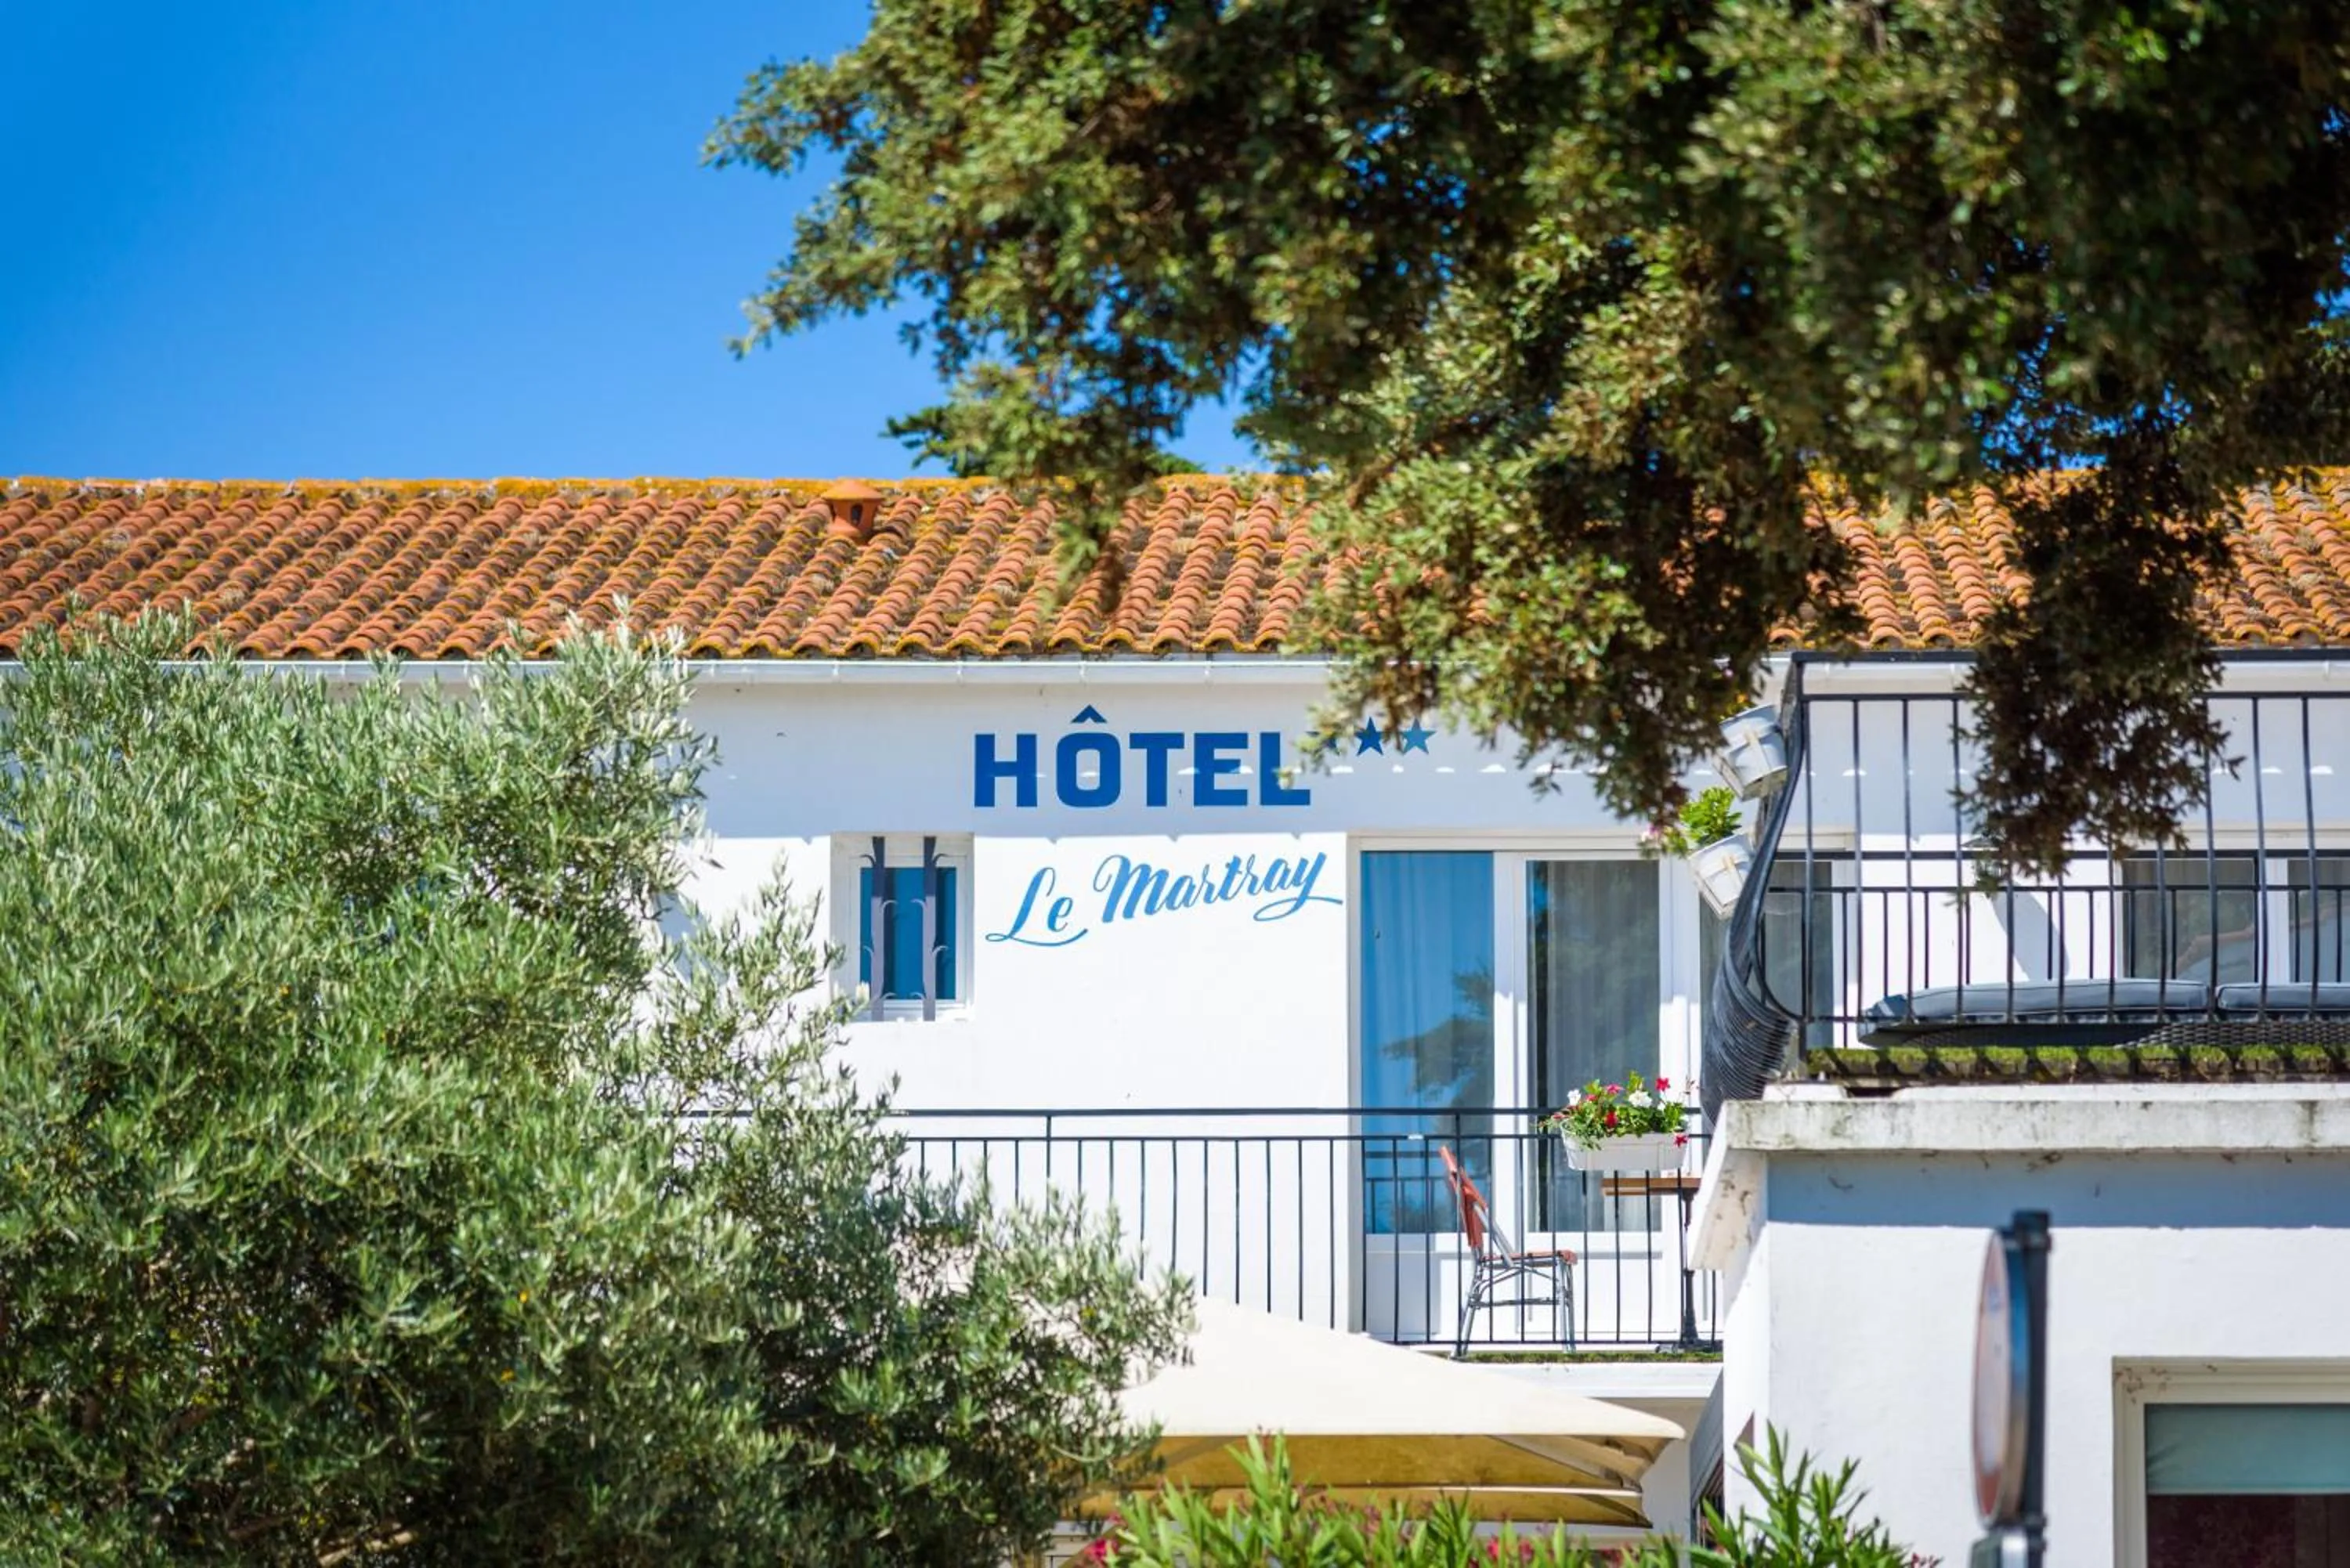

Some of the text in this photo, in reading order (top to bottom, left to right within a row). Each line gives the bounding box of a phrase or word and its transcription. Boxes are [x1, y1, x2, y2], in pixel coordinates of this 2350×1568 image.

[974, 705, 1311, 808] HÔTEL
[985, 851, 1343, 948] Le Martray
